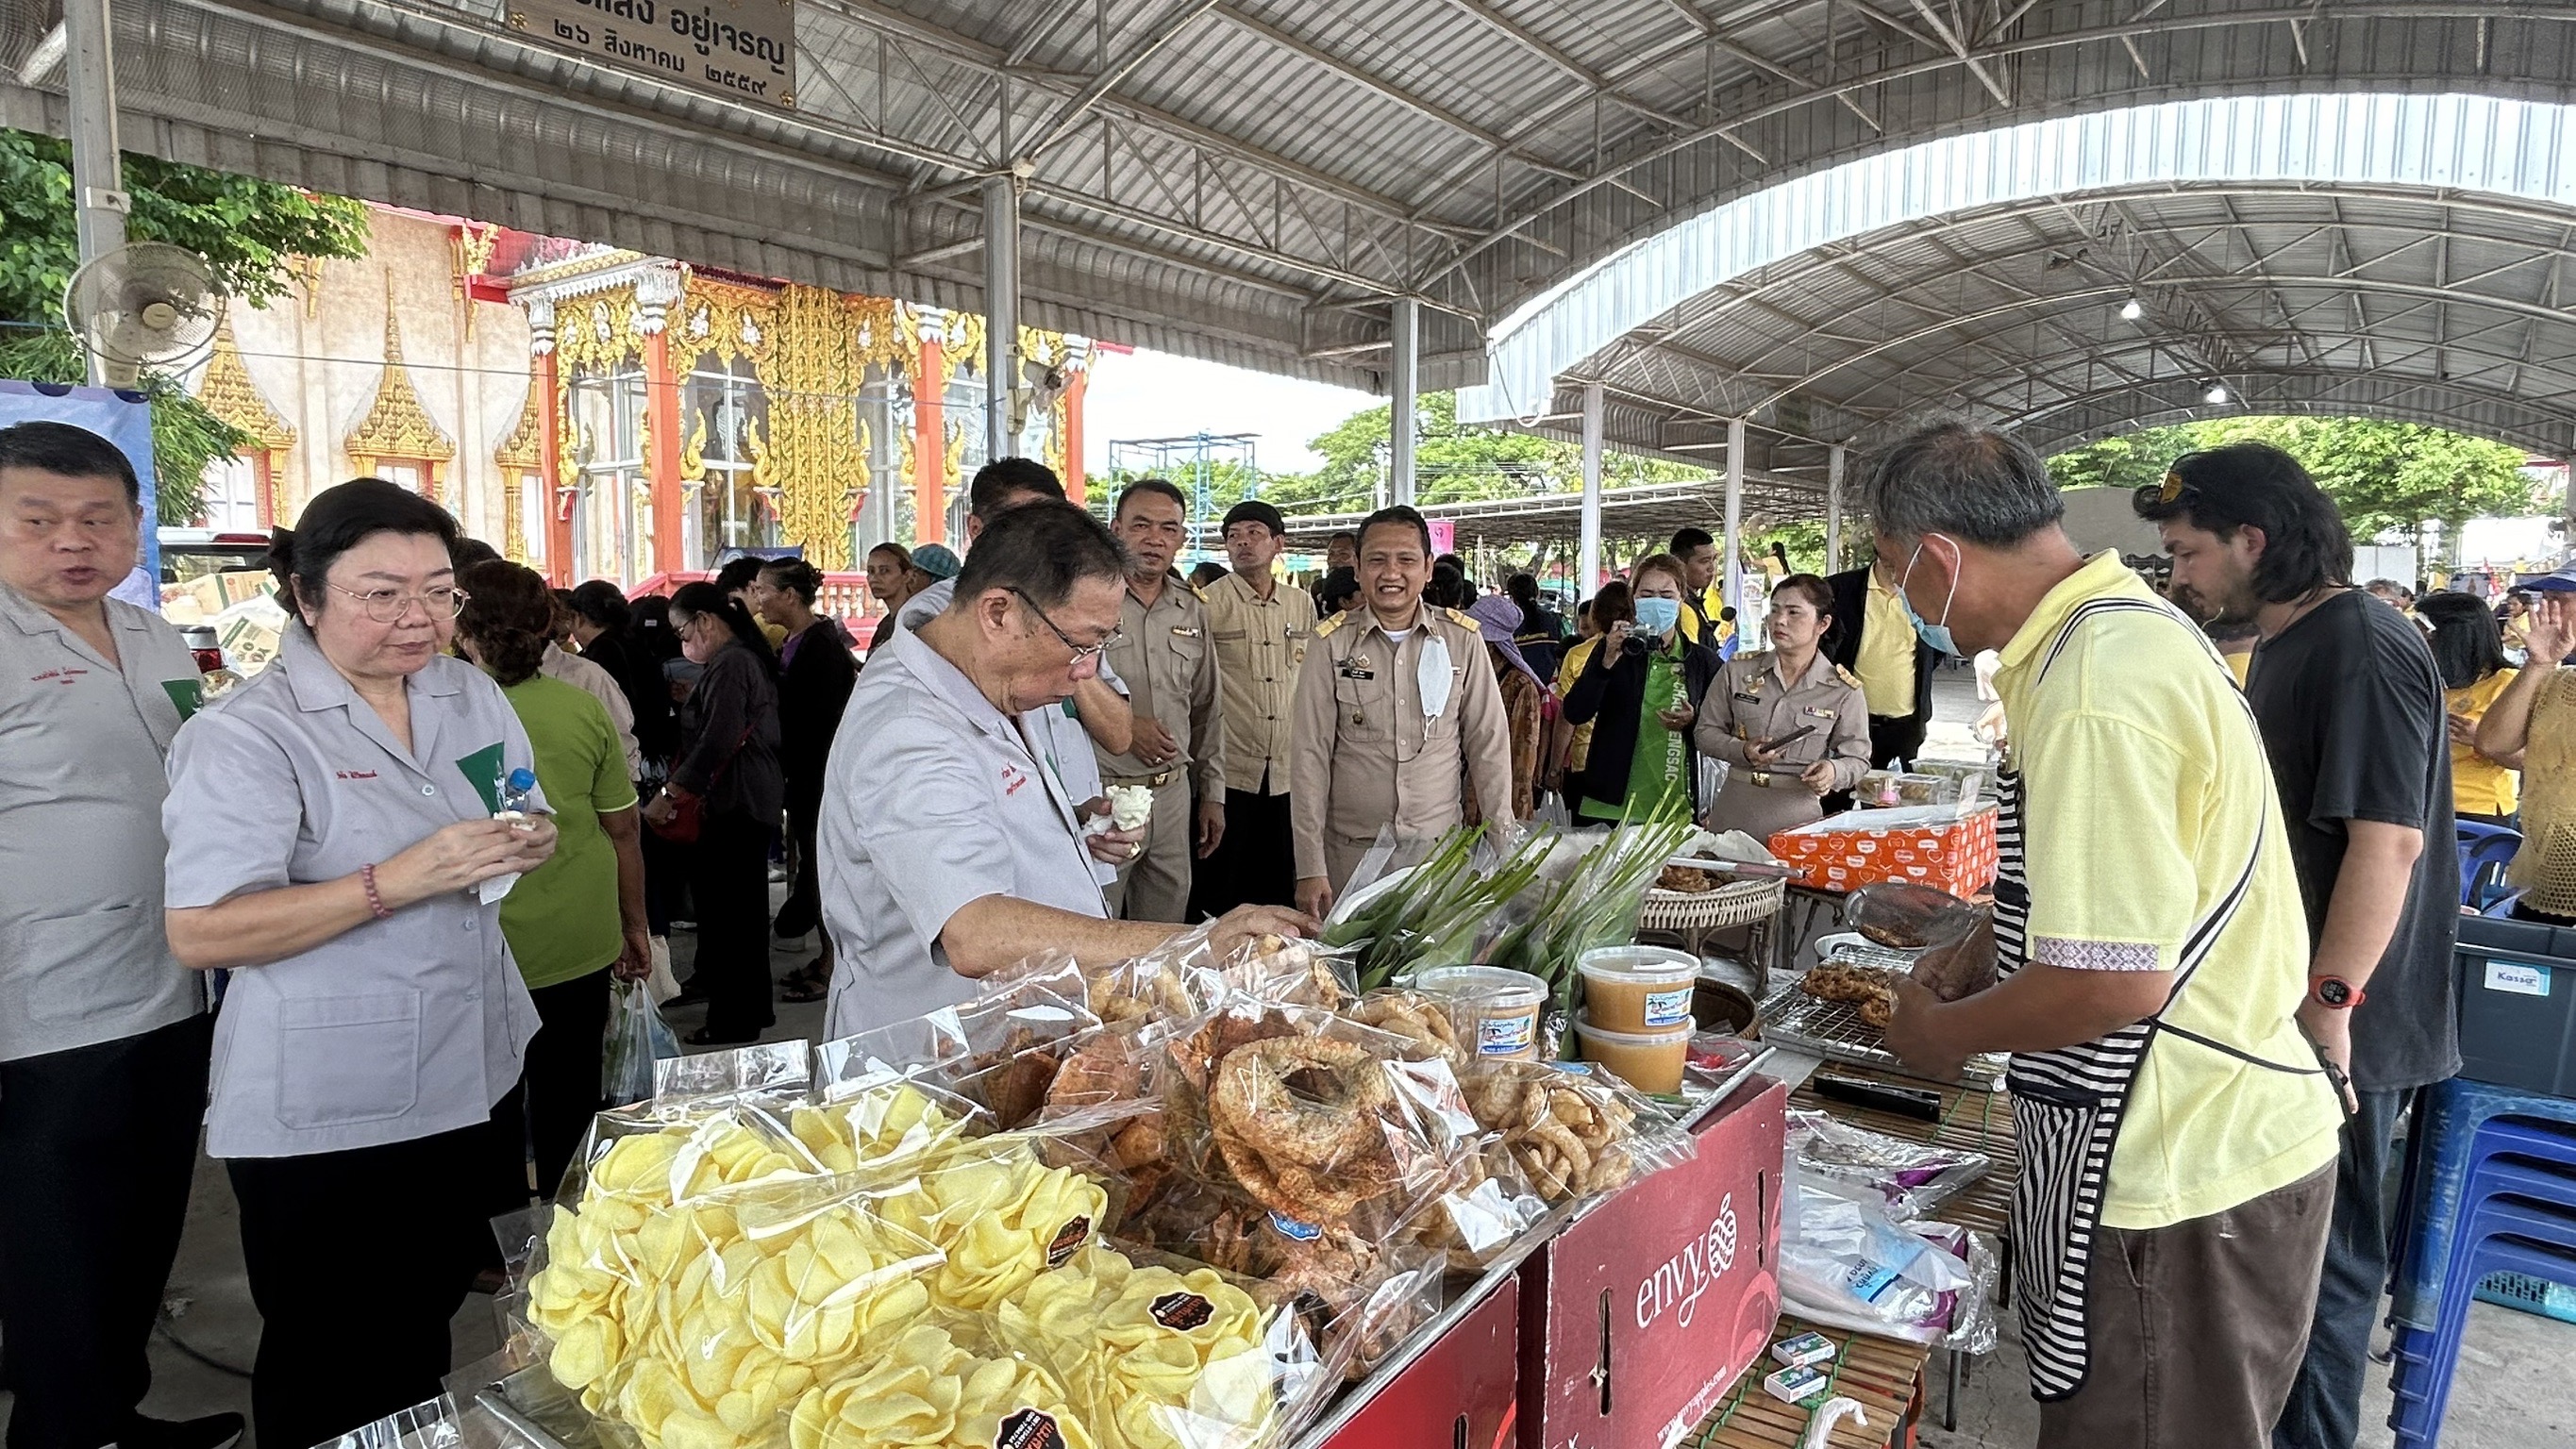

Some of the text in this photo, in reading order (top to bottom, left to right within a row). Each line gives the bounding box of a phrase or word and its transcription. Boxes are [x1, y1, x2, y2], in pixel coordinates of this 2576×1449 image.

[554, 18, 767, 96] ๒๖ สิงหาคม ๒๕๕๙
[1636, 1232, 1710, 1329] envy
